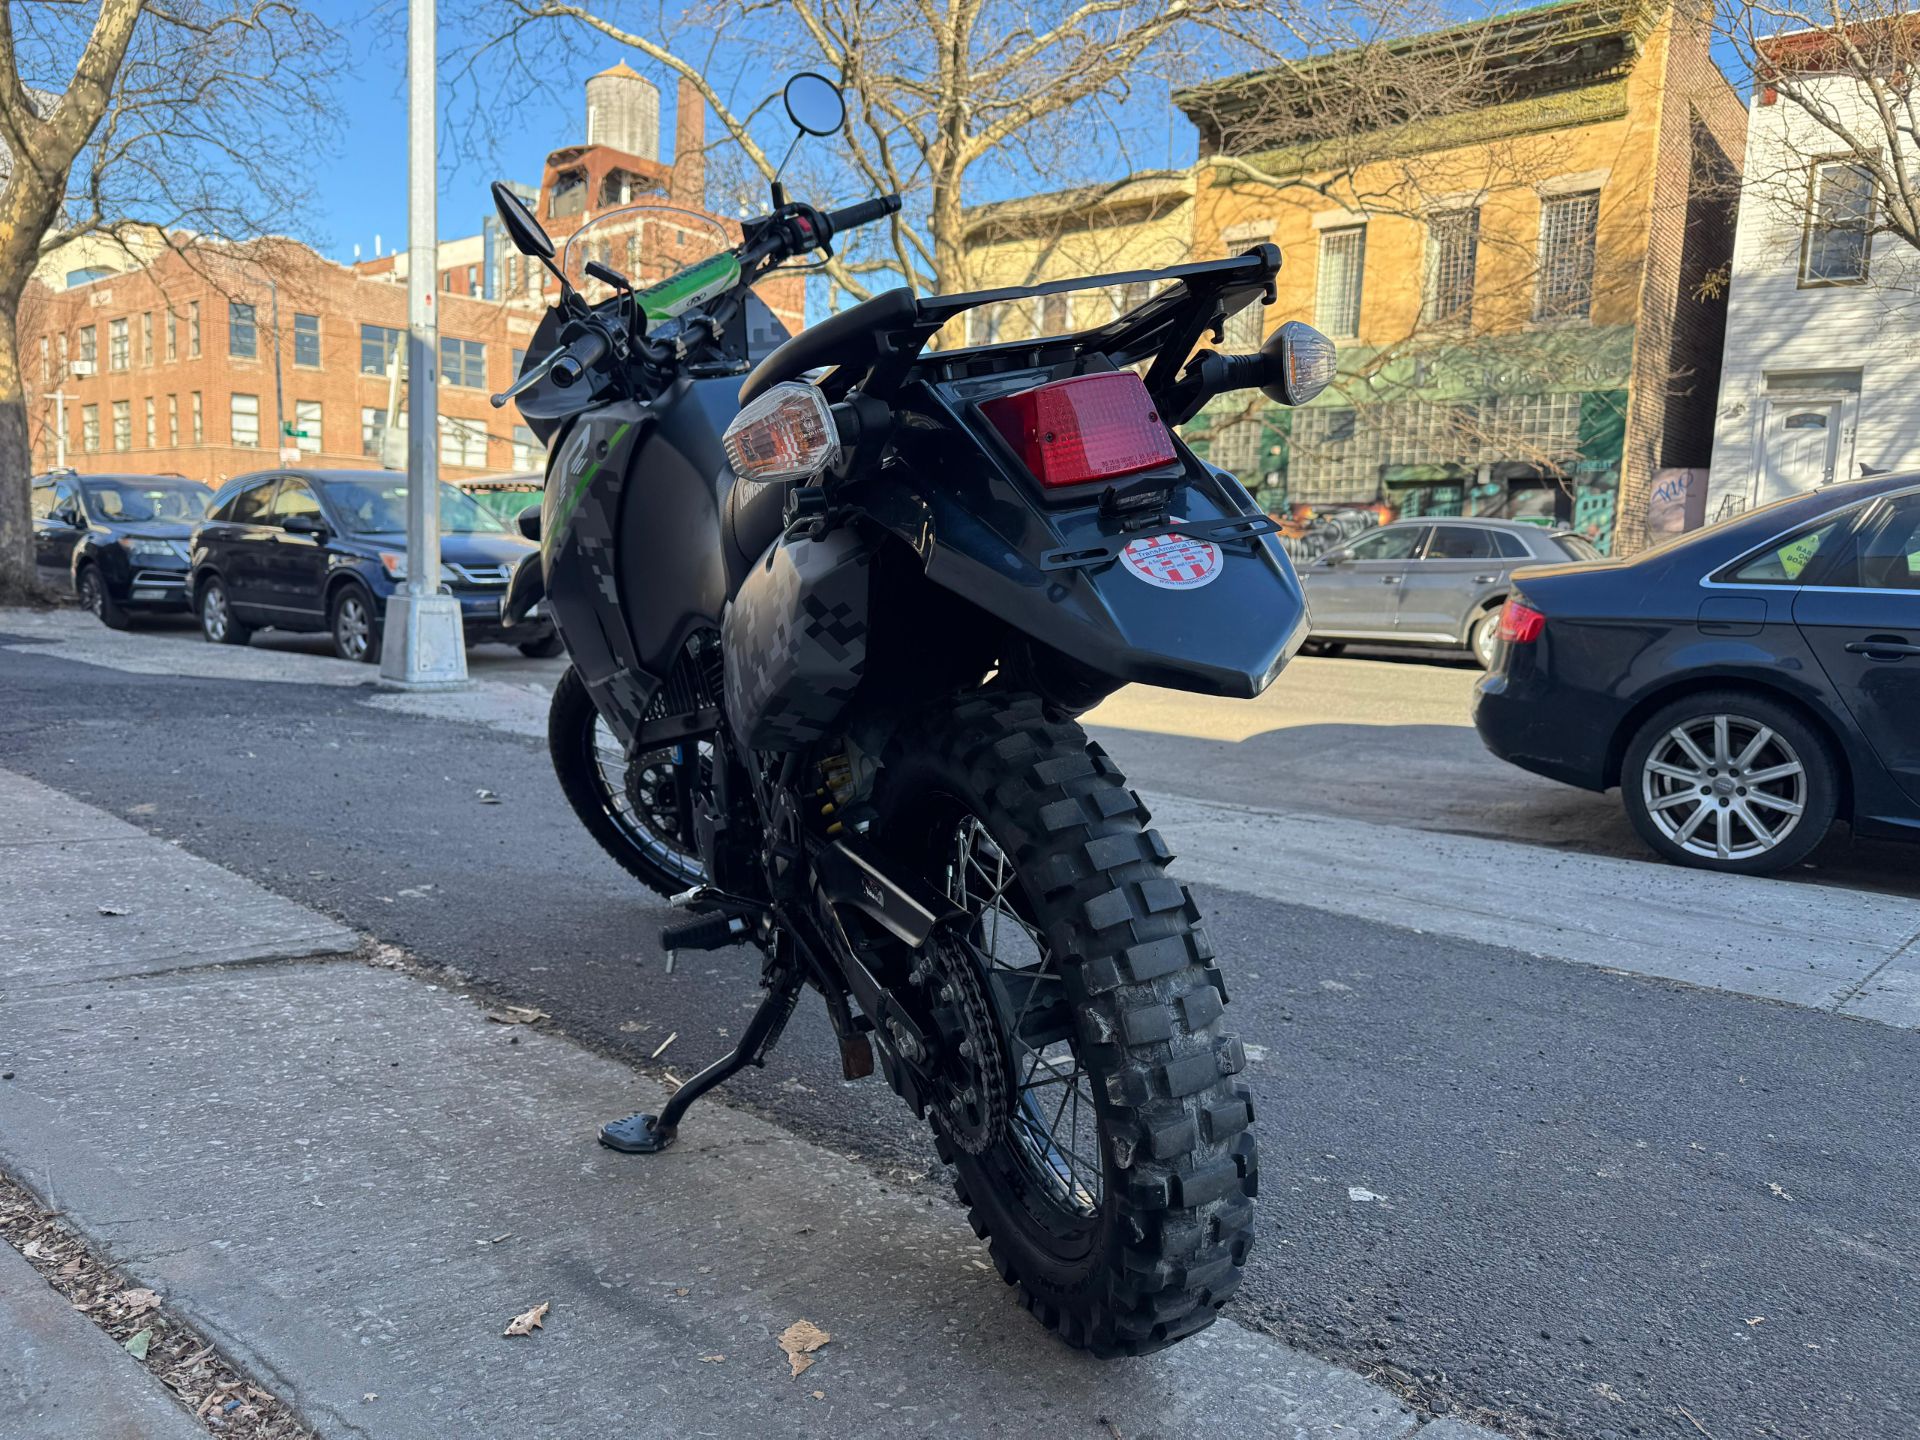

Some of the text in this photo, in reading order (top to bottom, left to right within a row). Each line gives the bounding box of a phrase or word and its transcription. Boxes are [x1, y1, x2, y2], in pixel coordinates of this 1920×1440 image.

[738, 481, 770, 510] Kawas
[1796, 545, 1813, 556] BAB
[1786, 556, 1807, 567] BOA
